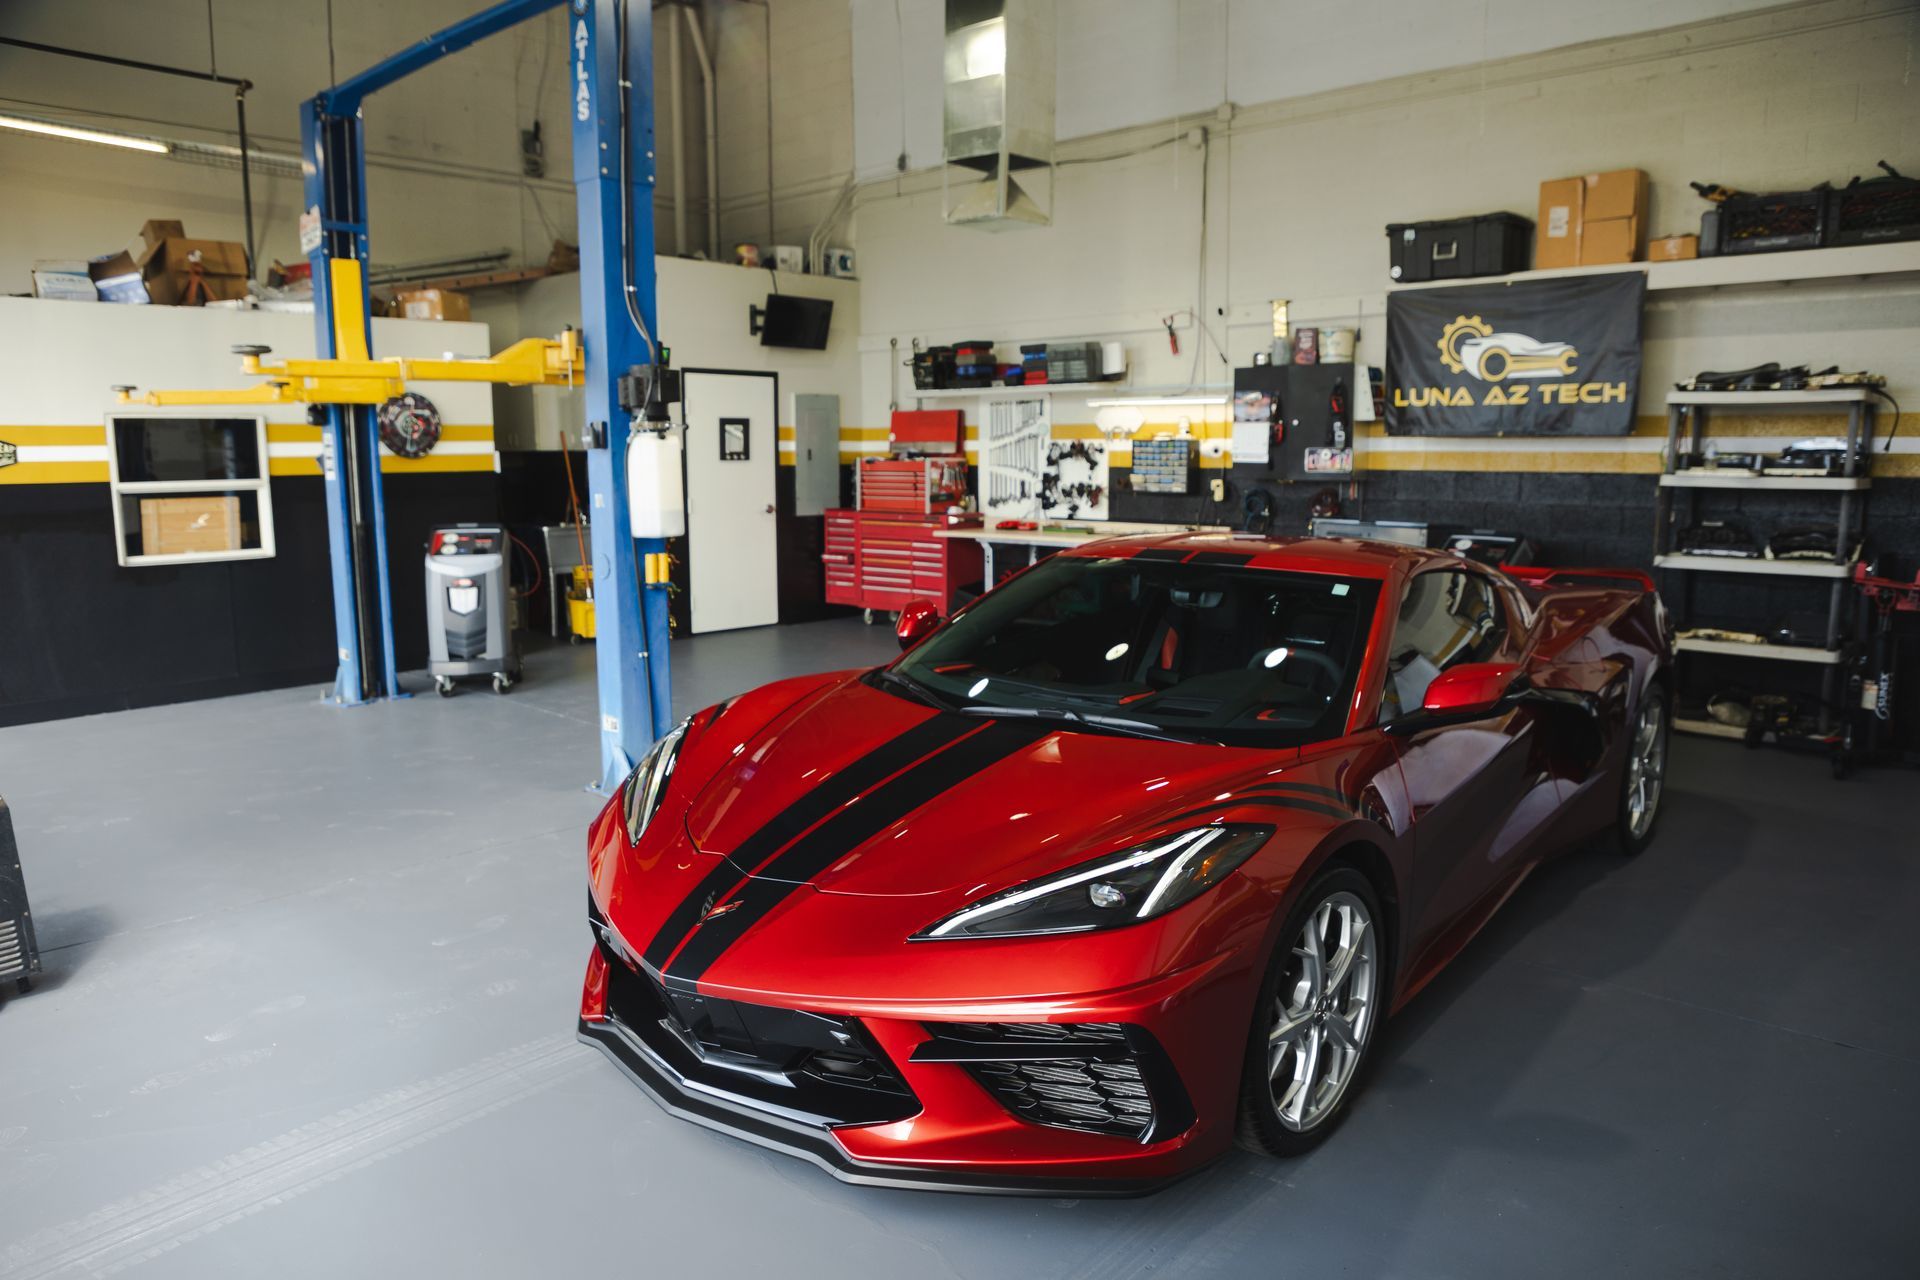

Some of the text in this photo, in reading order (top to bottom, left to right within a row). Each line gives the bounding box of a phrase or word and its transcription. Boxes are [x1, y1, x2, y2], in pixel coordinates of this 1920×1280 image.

[575, 19, 590, 121] ATLAS
[1394, 382, 1626, 407] LUNA AZ TECH
